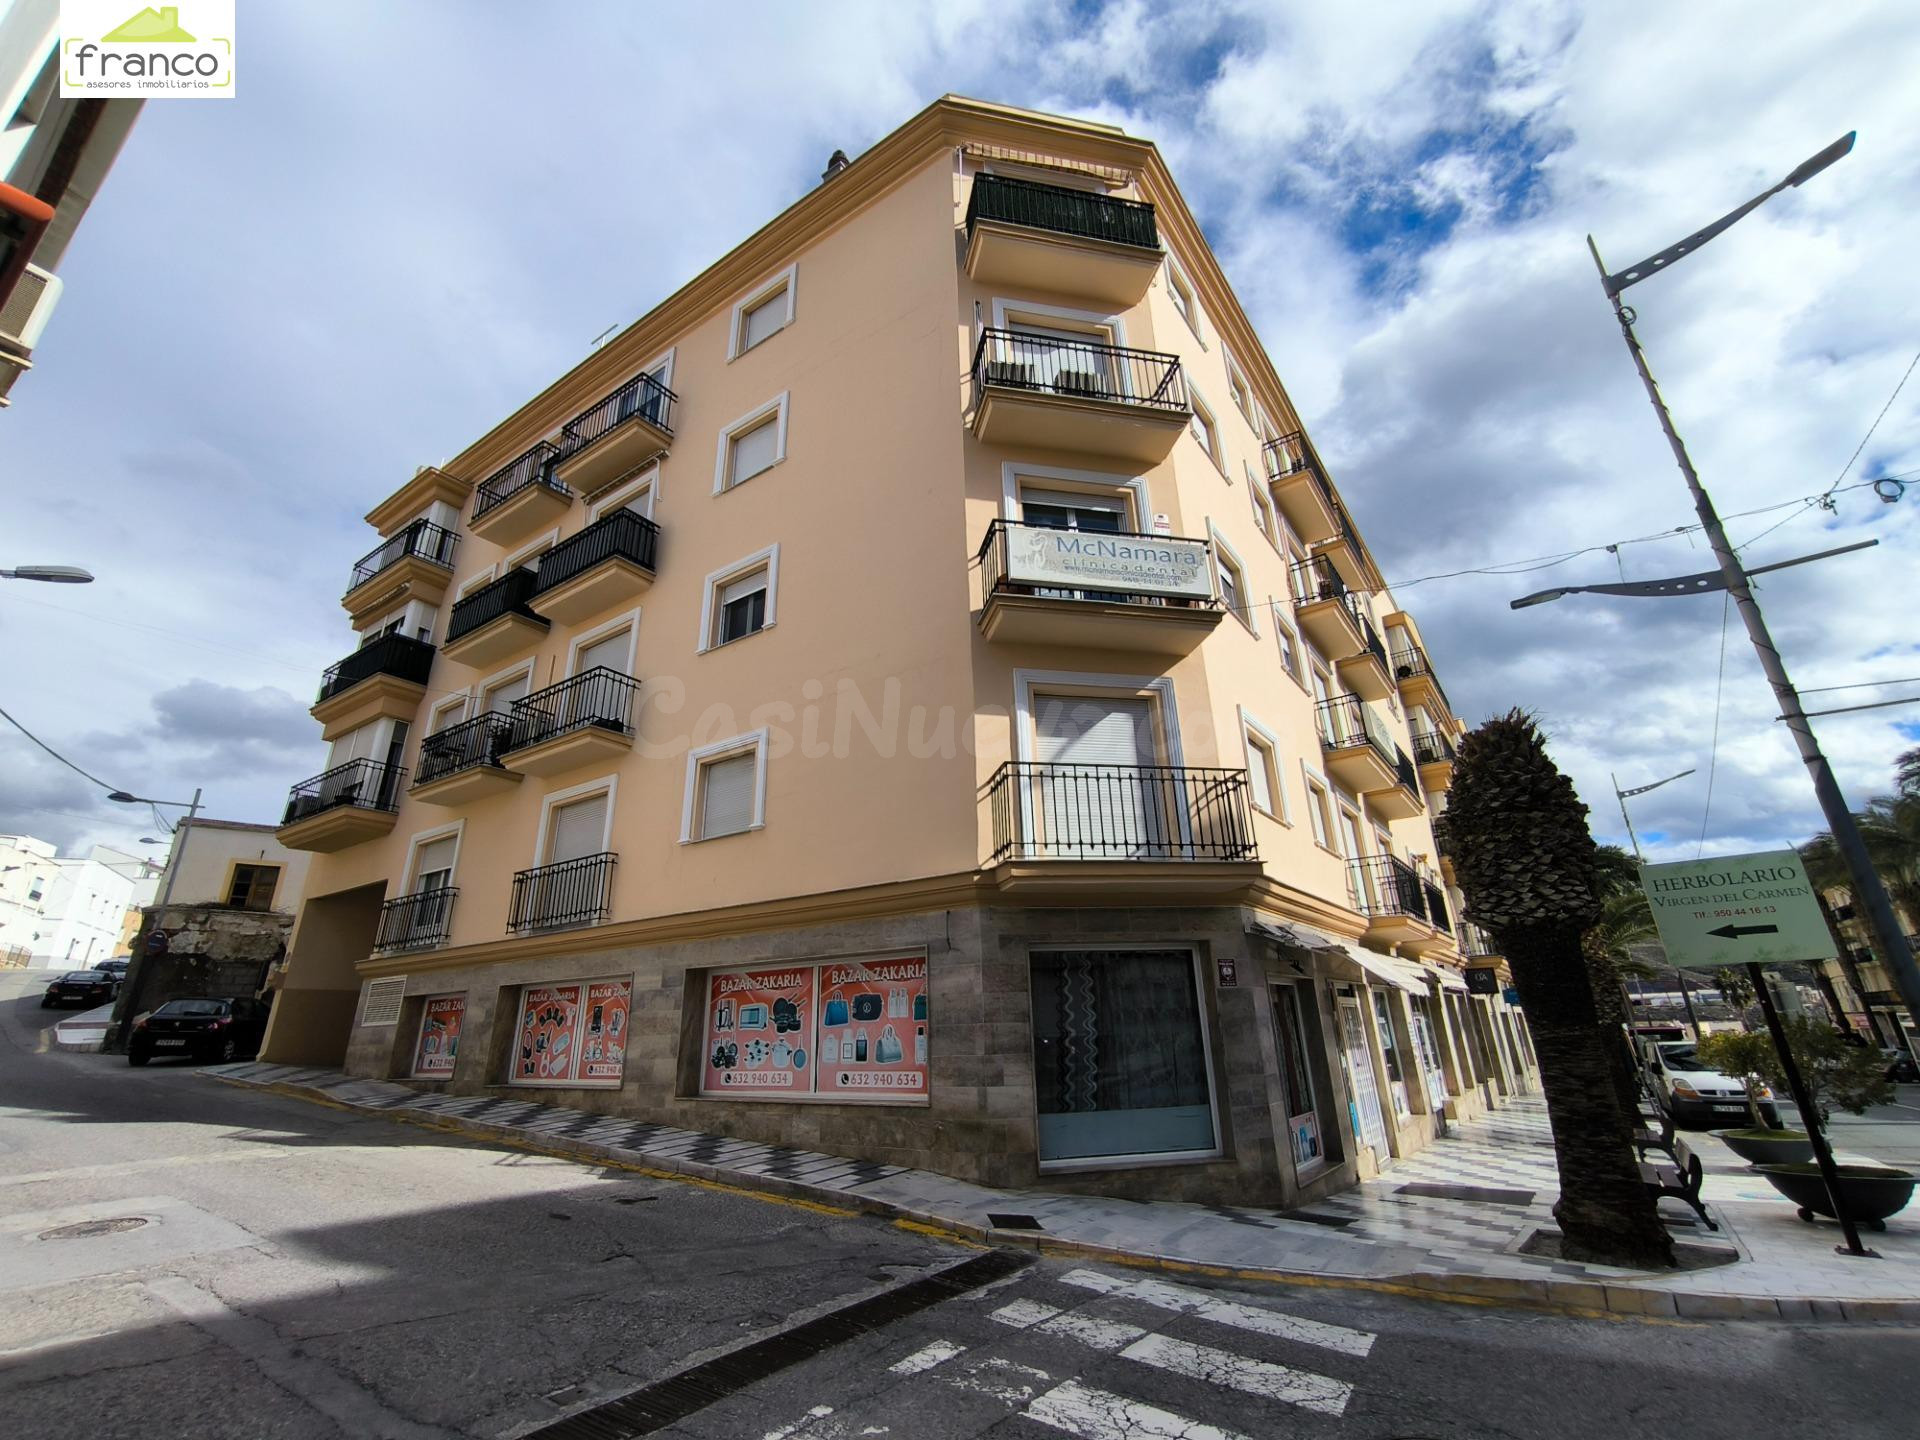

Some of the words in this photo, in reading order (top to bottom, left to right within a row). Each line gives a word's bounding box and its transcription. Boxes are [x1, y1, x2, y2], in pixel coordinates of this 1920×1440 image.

[1056, 536, 1197, 565] McNamara
[1652, 866, 1796, 892] HERBOLARIO
[1653, 894, 1709, 908] VIRGEN
[1711, 893, 1740, 903] DEL
[1742, 885, 1809, 901] CARMEN
[1713, 908, 1733, 918] 950
[1734, 907, 1747, 916] 44
[1764, 904, 1777, 914] 13
[720, 978, 753, 993] BAZAR
[756, 973, 803, 989] ZAKARIA
[831, 968, 869, 984] BAZAR
[873, 963, 928, 980] ZAKARIA
[732, 1072, 749, 1083] 632
[751, 1072, 768, 1083] 940
[771, 1072, 788, 1083] 634
[850, 1073, 869, 1085] 632
[873, 1073, 893, 1085] 940
[896, 1073, 917, 1086] 634
